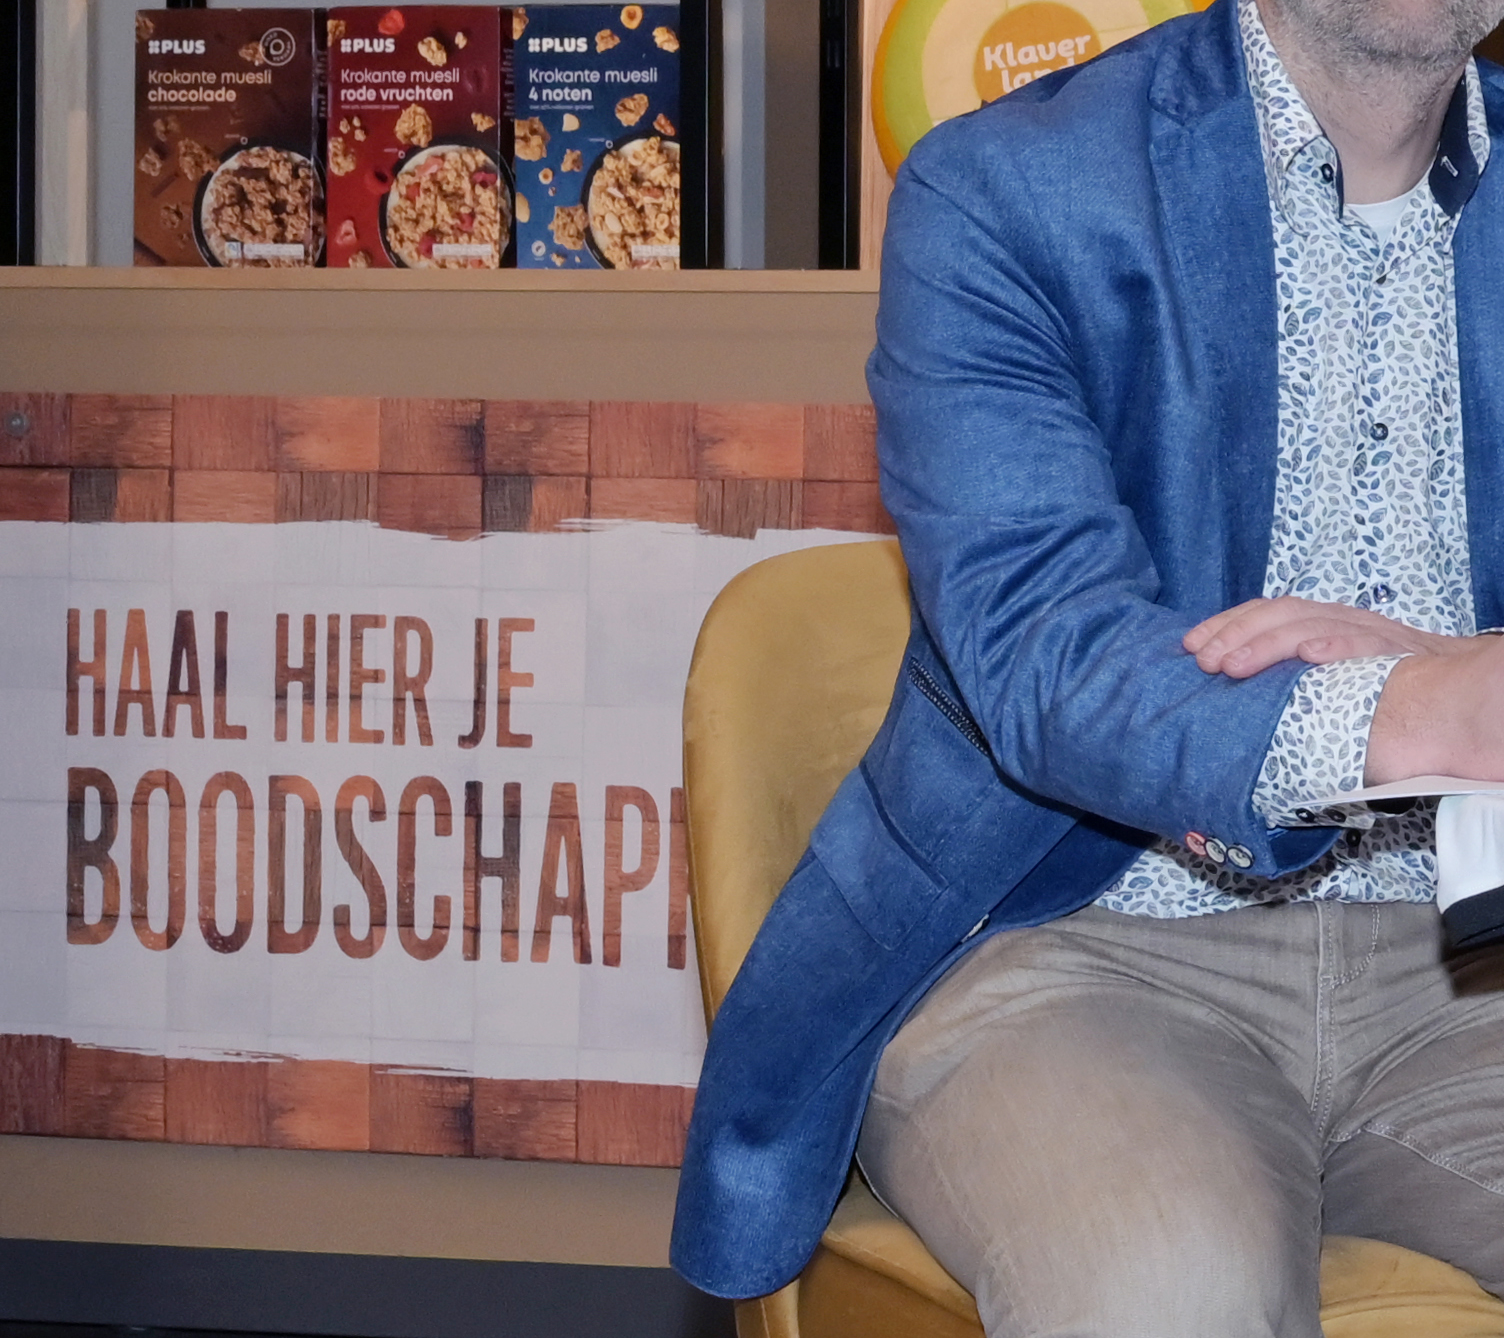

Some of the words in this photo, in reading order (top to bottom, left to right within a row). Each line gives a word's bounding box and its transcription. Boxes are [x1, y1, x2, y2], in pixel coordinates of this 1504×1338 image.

[161, 40, 205, 54] PLUS
[353, 38, 395, 53] PLUS
[541, 37, 588, 53] PLUS
[984, 35, 1091, 71] Klaver
[149, 70, 216, 85] Krokante
[221, 69, 272, 84] muesli
[341, 68, 407, 84] Krokante
[410, 67, 460, 83] muesli
[529, 67, 600, 83] Krokante
[605, 67, 658, 83] muesli
[1001, 57, 1075, 93] la
[148, 86, 237, 102] chocolade
[340, 86, 376, 102] rode
[380, 86, 454, 102] vruchten
[528, 86, 539, 101] 4
[542, 87, 592, 102] noten
[66, 609, 247, 740] HAAL
[275, 613, 433, 747] HIER
[458, 617, 536, 749] JE
